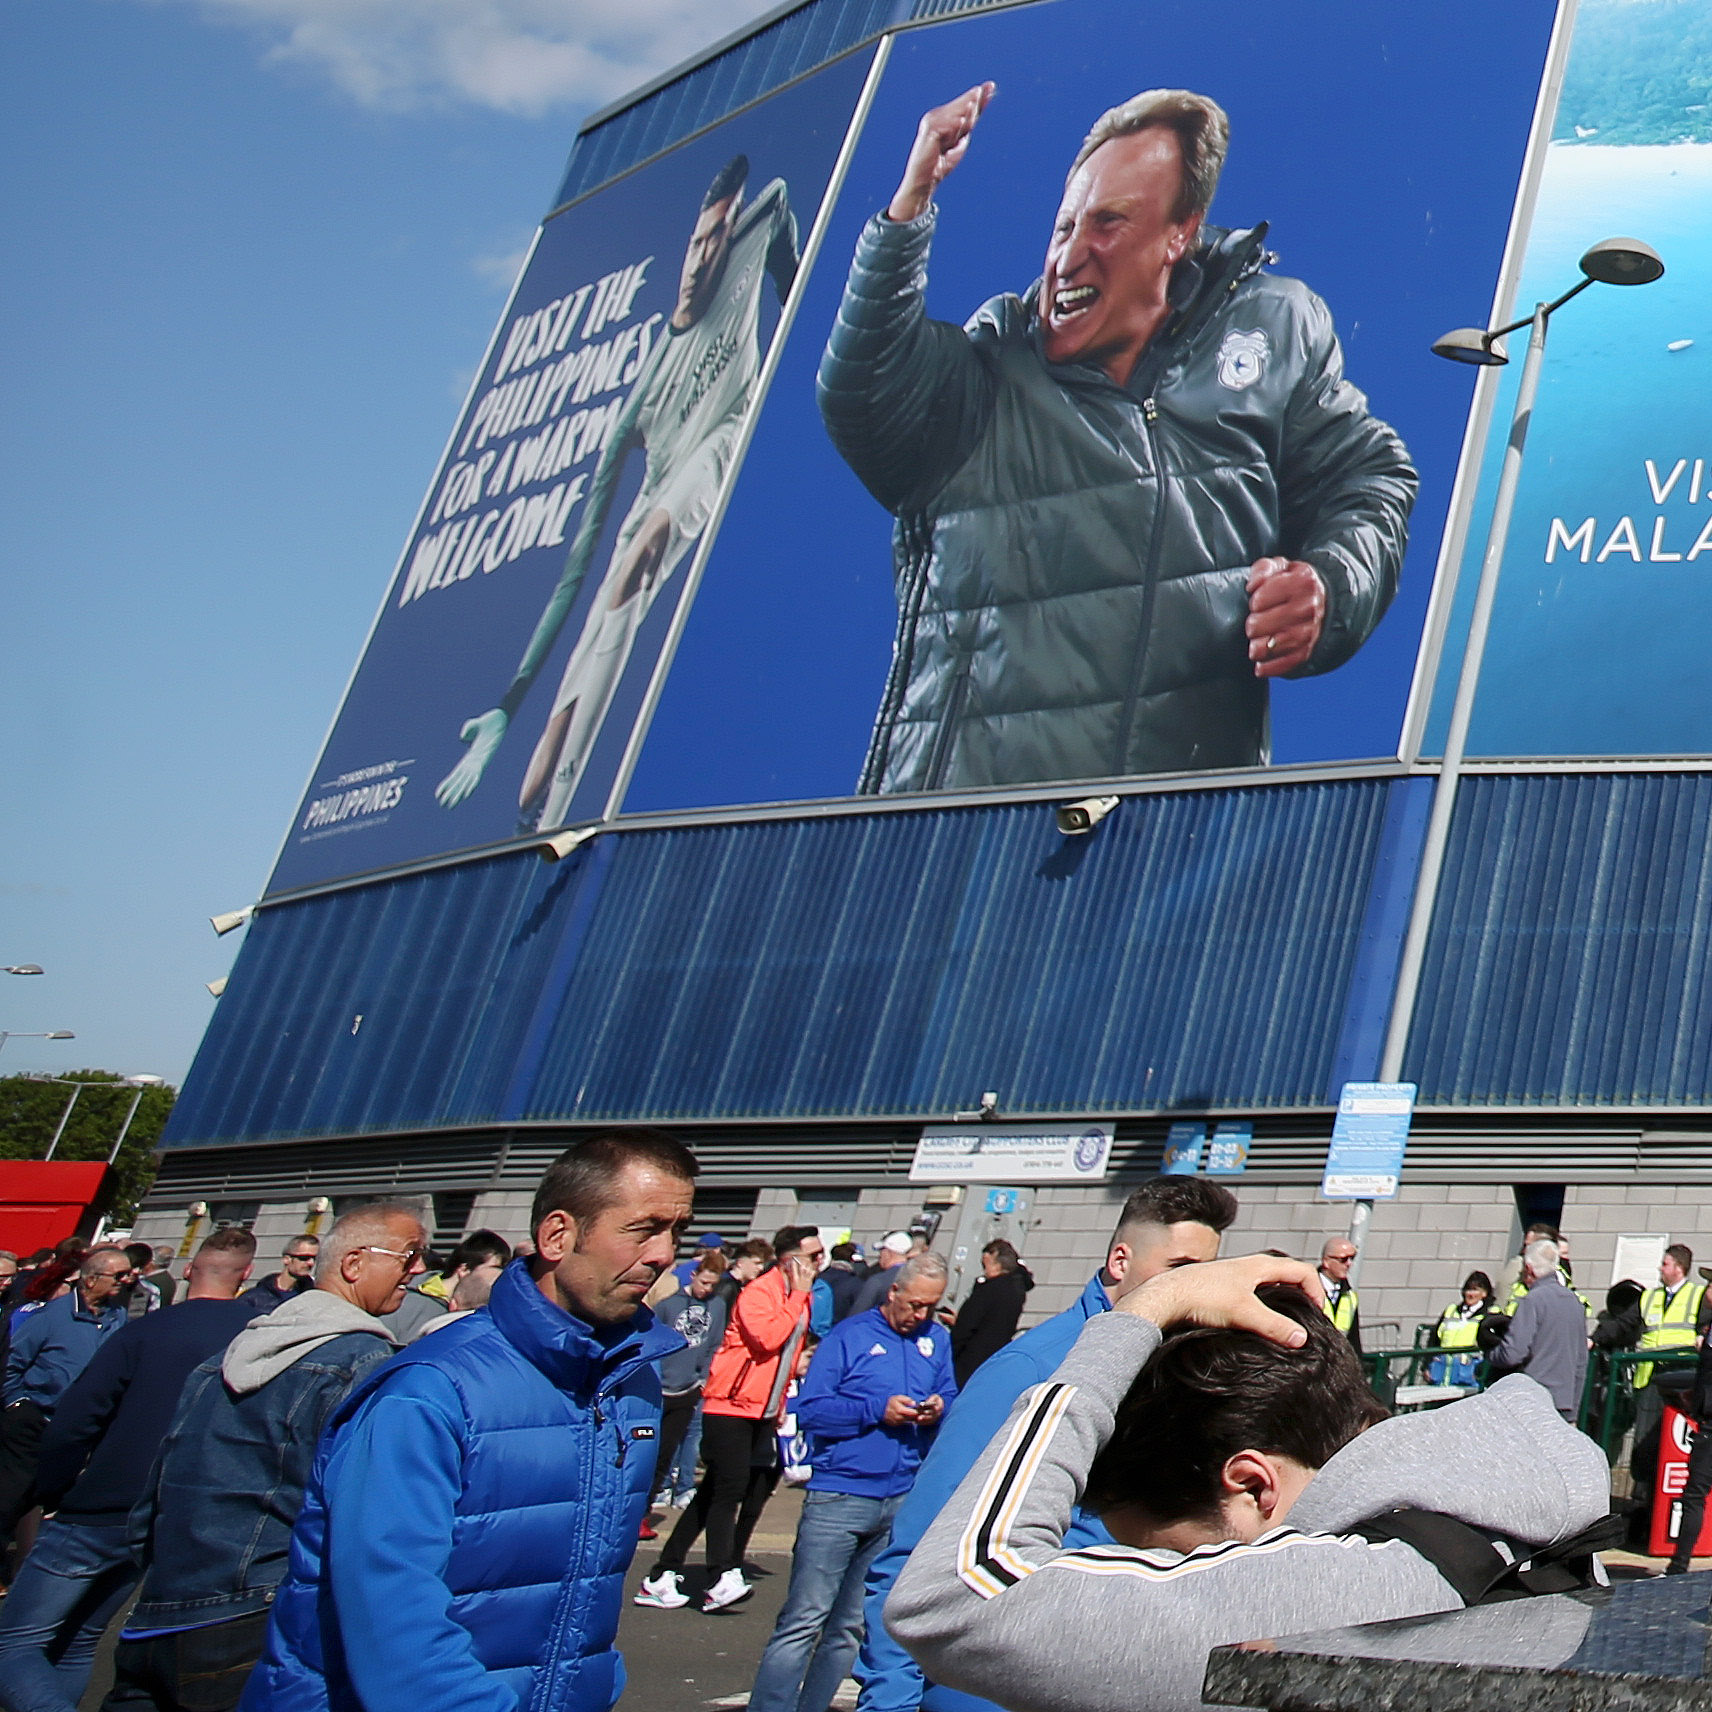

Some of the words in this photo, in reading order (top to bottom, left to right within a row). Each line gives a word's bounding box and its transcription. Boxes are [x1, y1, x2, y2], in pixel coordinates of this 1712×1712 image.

[457, 311, 664, 459] PHILIPPINES
[494, 282, 596, 386] VISIT
[580, 255, 655, 340] THE
[429, 448, 497, 527] FOR
[485, 439, 519, 498] A
[506, 395, 624, 496] WARM
[398, 472, 589, 610] WELCOME
